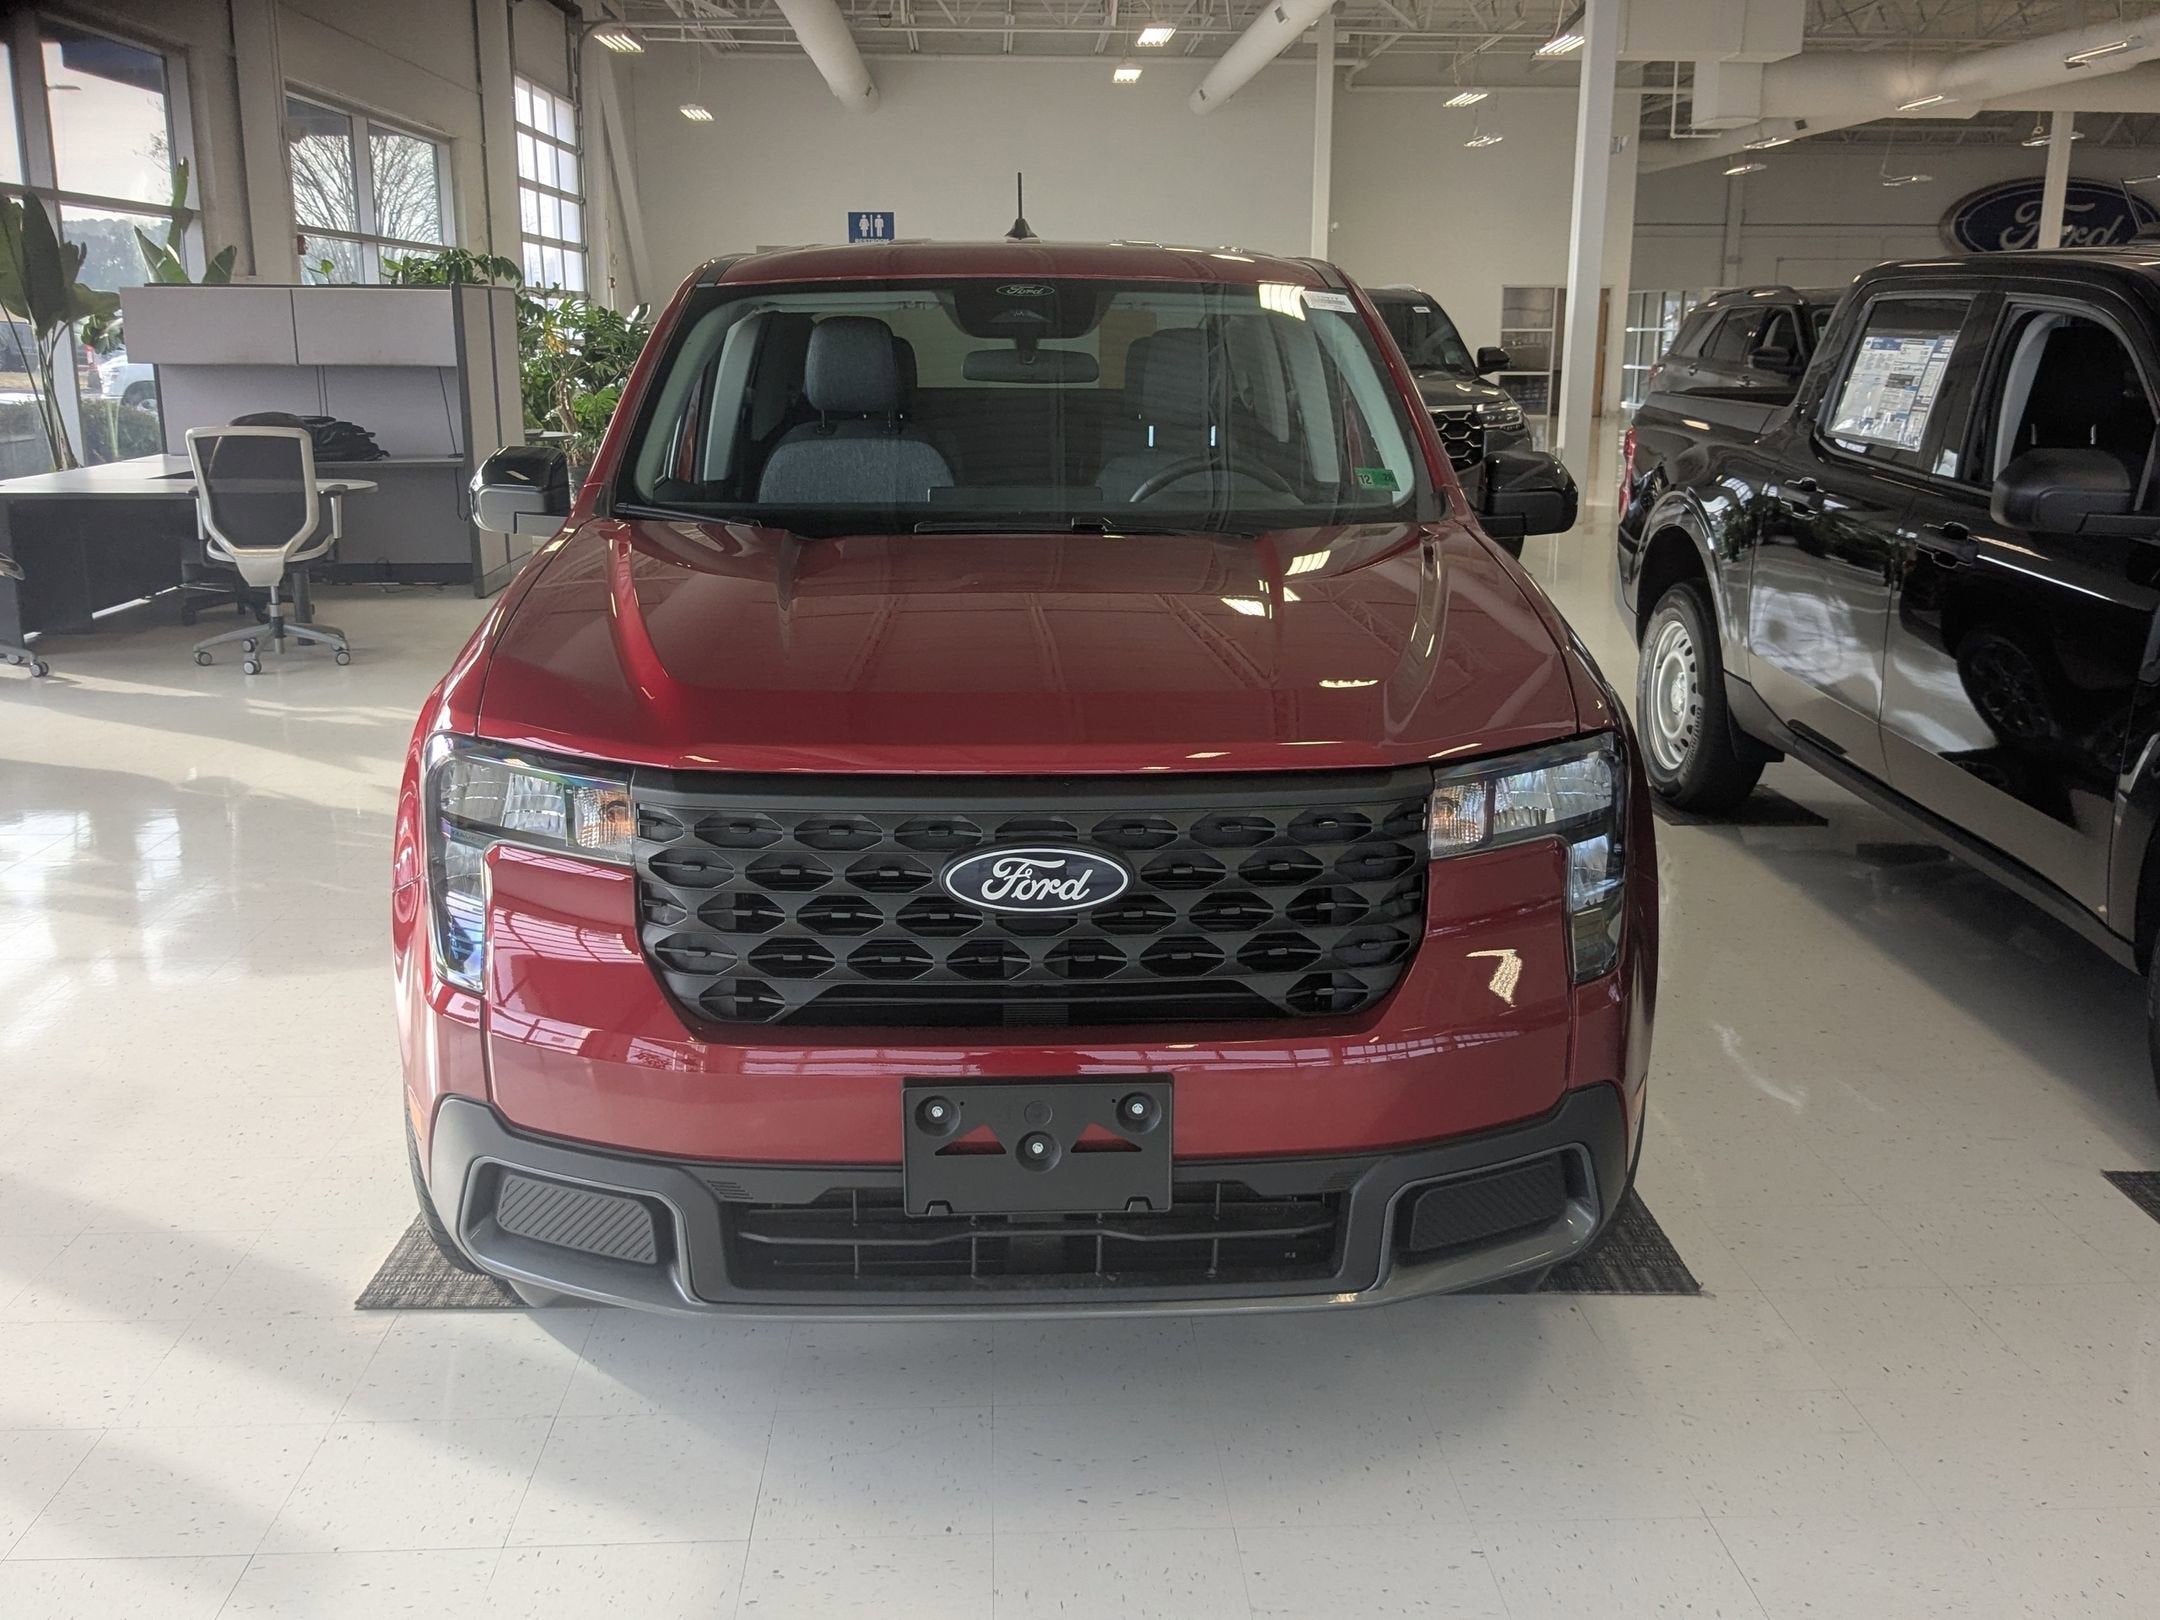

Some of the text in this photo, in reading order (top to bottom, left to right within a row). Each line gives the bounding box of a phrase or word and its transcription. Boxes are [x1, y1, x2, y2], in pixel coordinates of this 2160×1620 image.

[1999, 200, 2125, 250] Frd
[1006, 286, 1043, 295] Ford
[1359, 474, 1372, 485] 12
[981, 857, 1093, 901] Ford
